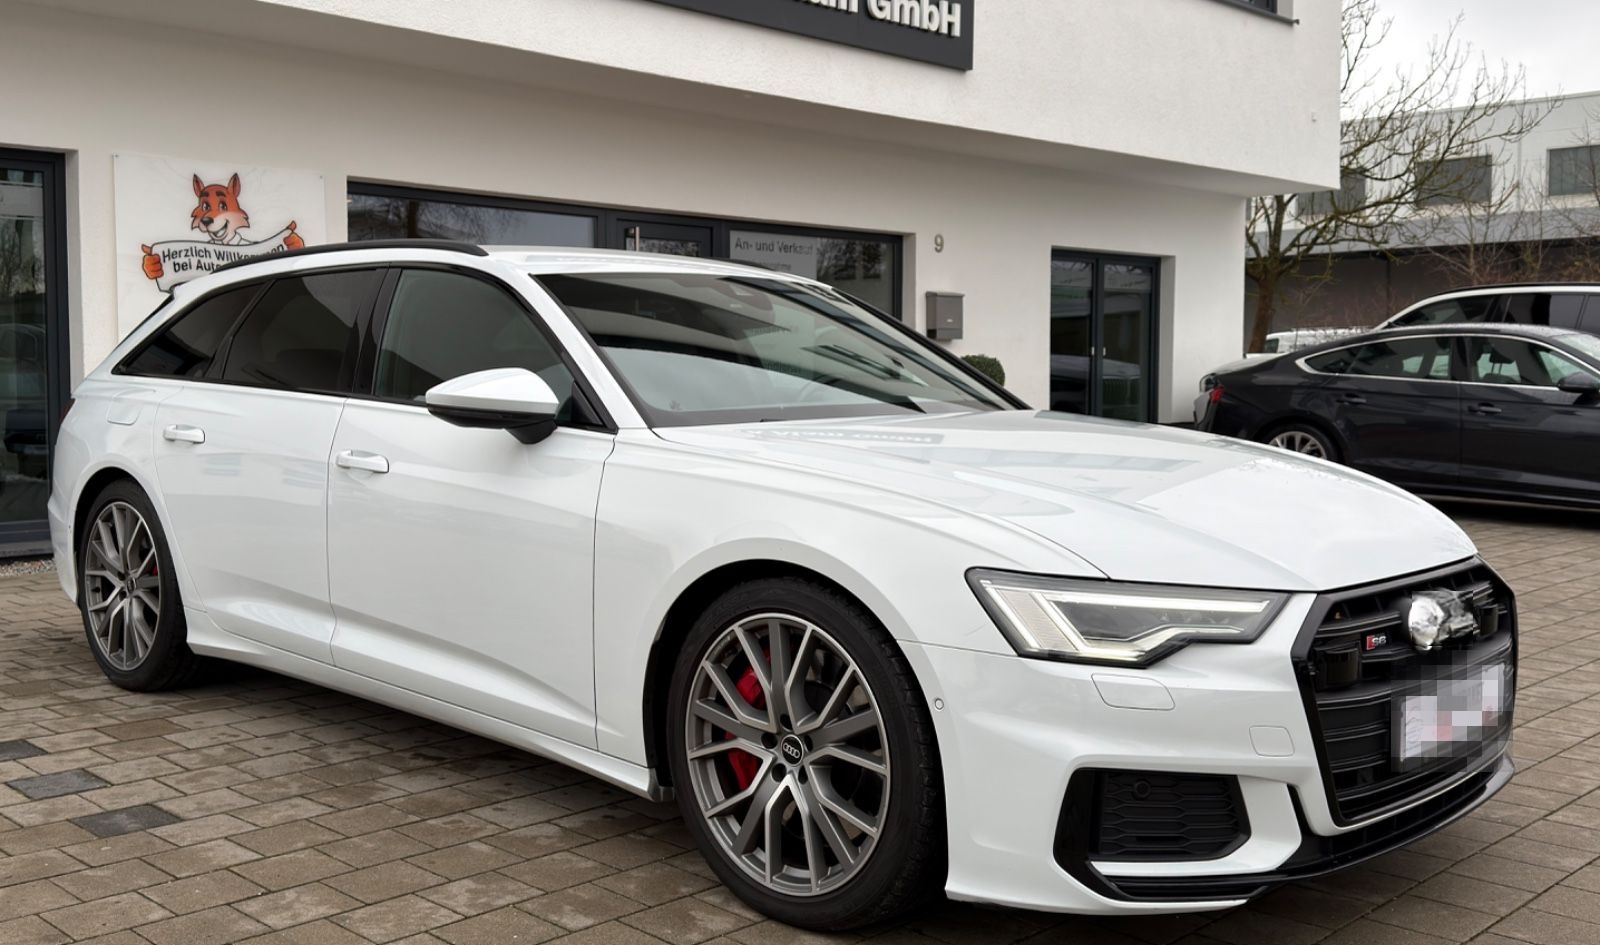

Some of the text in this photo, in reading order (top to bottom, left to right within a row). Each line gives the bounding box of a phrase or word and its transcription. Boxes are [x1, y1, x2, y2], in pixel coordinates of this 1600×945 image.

[867, 0, 961, 37] GmbH
[734, 237, 752, 250] An-
[756, 240, 774, 252] und
[934, 233, 944, 253] 9
[162, 246, 211, 262] Herzlich
[173, 259, 193, 273] bei
